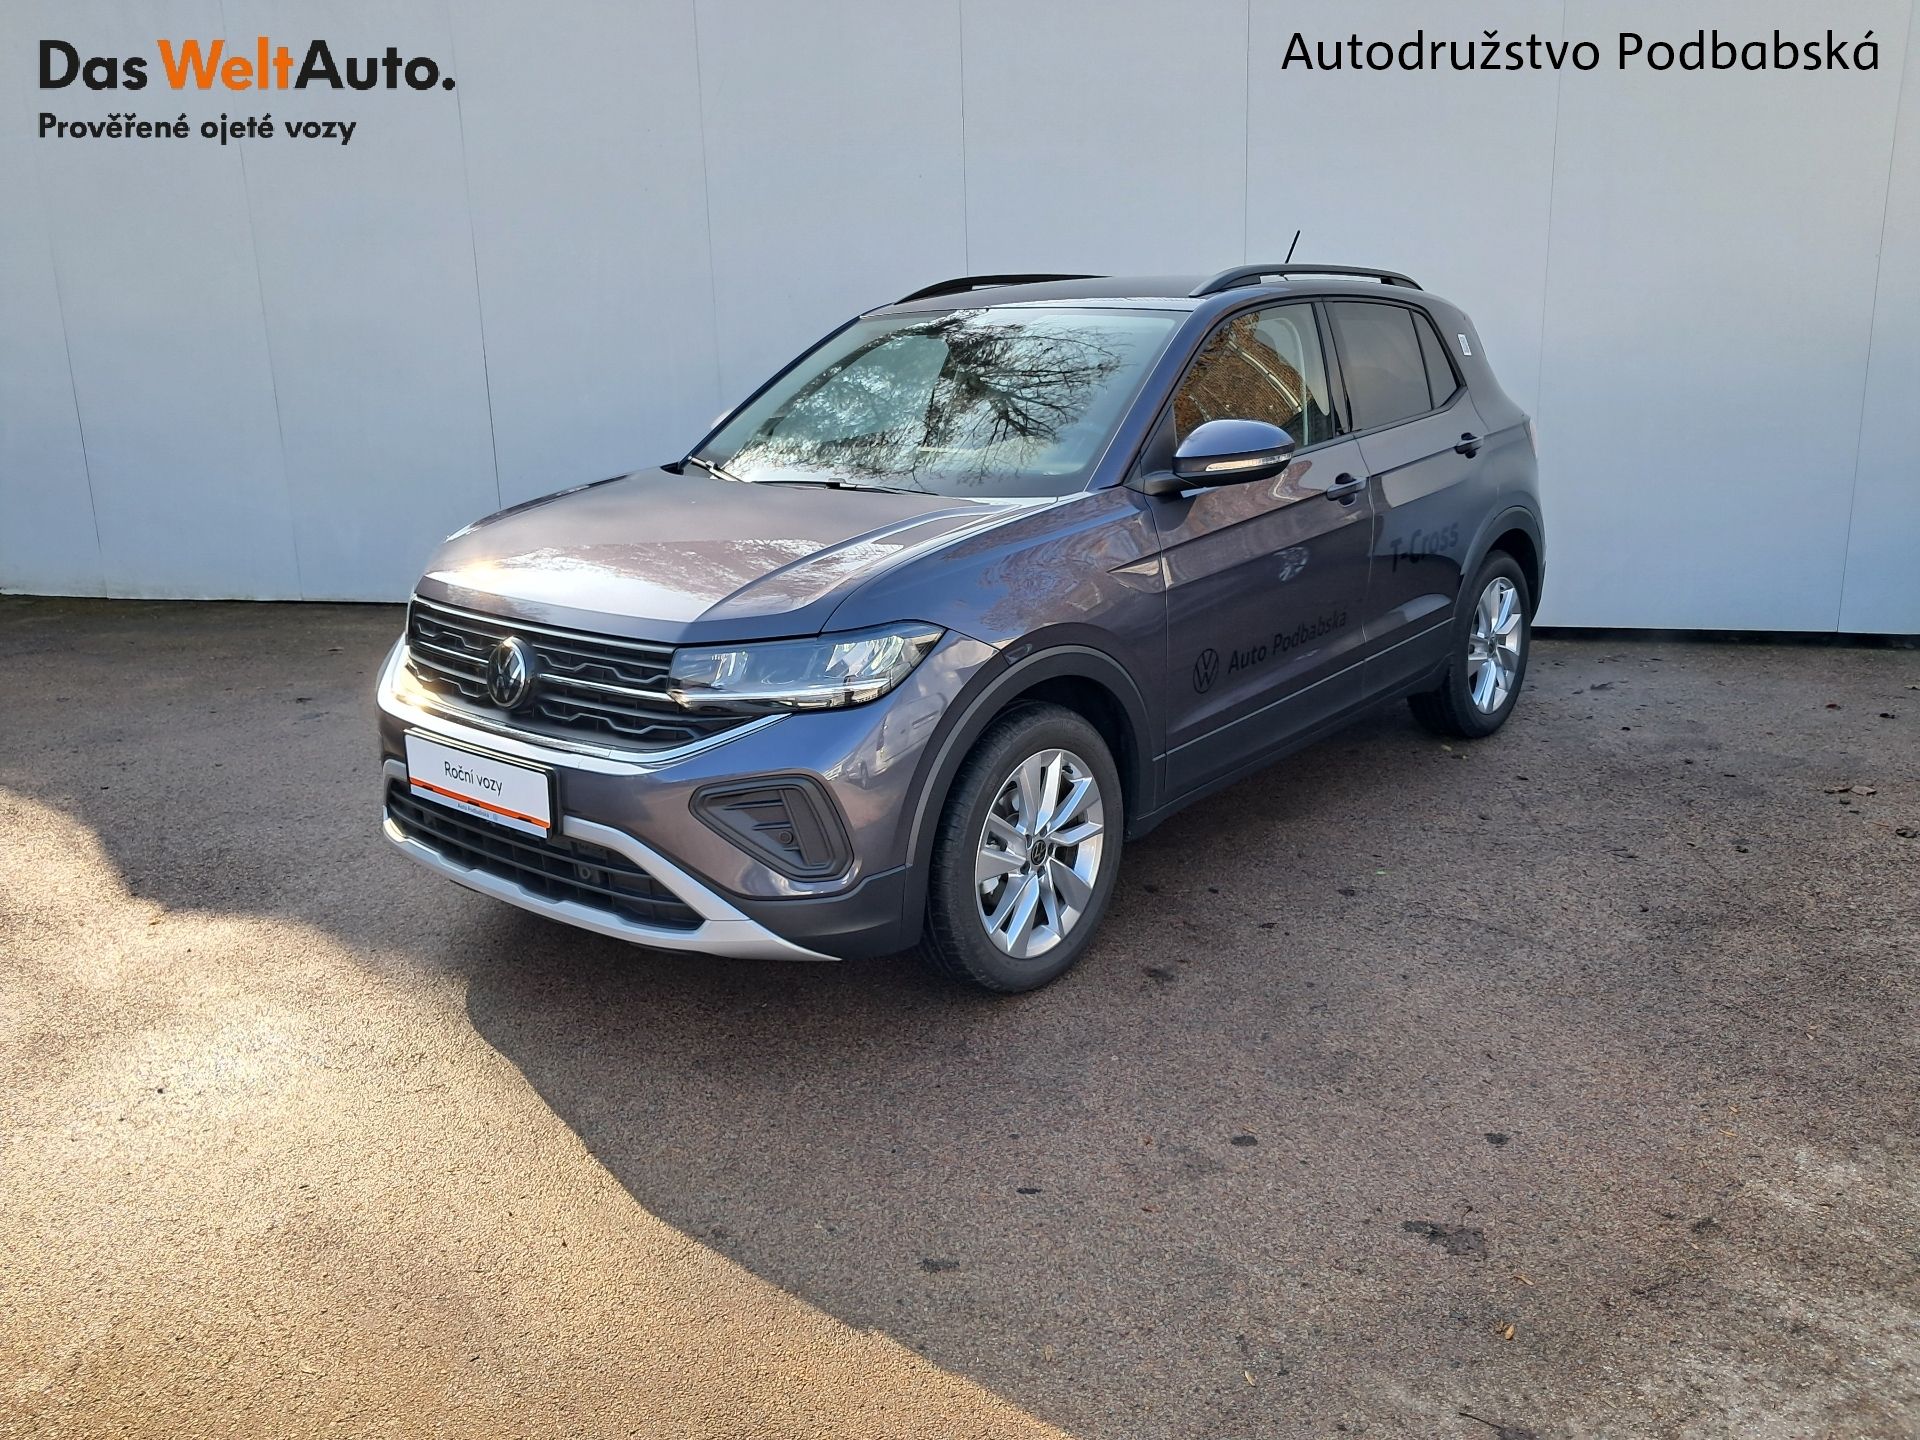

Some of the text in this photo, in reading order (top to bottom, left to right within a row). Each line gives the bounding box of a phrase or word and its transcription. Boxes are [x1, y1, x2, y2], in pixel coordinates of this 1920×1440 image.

[1390, 522, 1459, 573] T-Cross
[1228, 645, 1267, 674] Auto
[444, 760, 503, 797] Roční vozy
